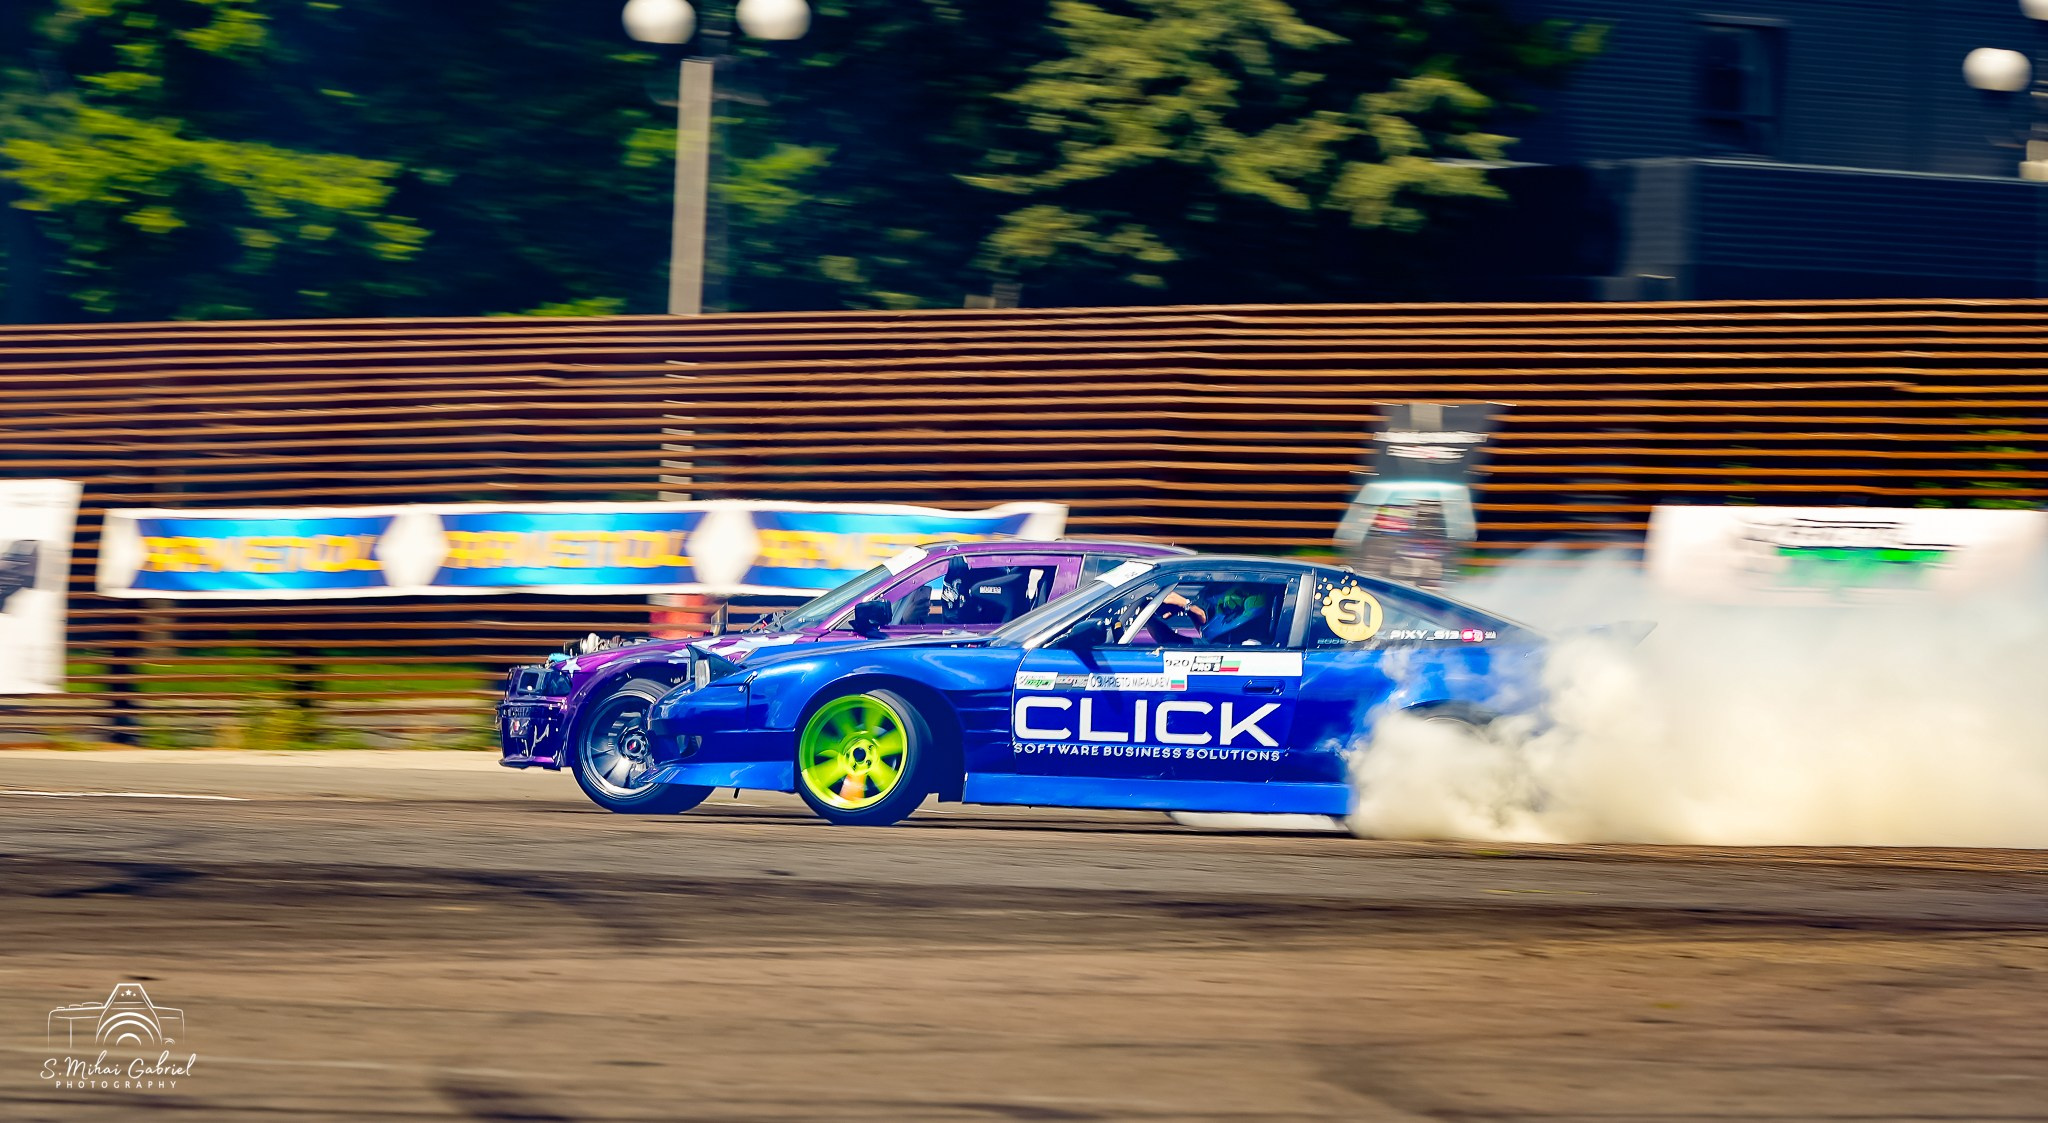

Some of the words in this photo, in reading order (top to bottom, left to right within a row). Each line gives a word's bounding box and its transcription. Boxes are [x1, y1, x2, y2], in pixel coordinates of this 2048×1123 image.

[1015, 696, 1281, 747] CLICK
[1014, 742, 1099, 756] SOFTWARE
[1103, 746, 1182, 758] BUSINESS
[1185, 749, 1280, 762] SOLUTIONS
